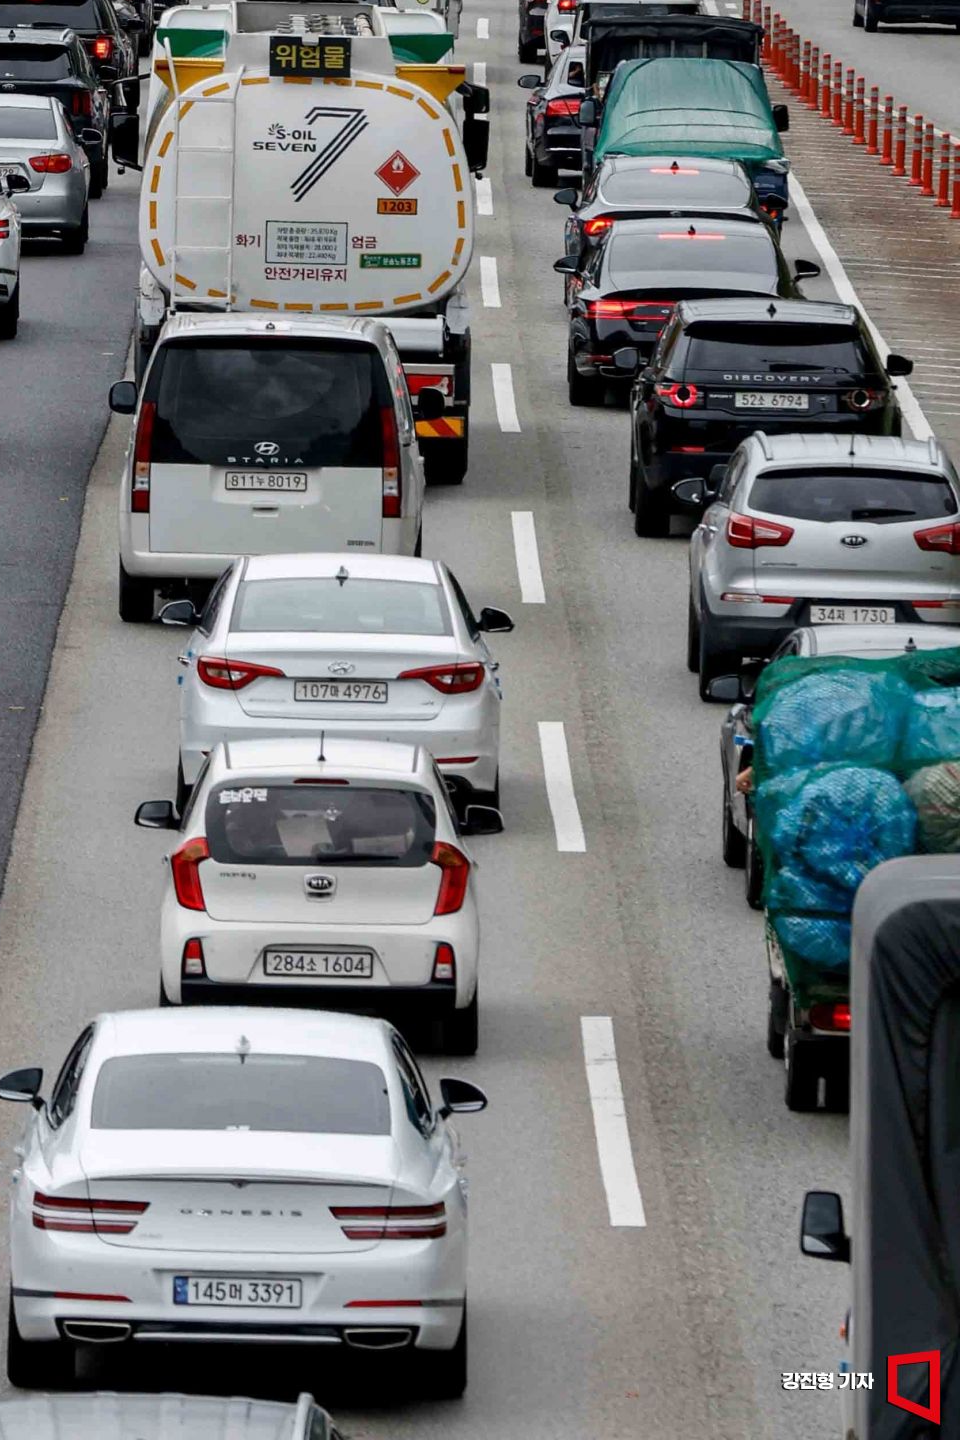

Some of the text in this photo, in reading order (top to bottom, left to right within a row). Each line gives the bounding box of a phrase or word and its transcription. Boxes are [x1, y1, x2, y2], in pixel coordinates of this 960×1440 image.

[276, 45, 345, 68] 위험물
[276, 129, 316, 140] S-OIL
[253, 142, 316, 153] SEVEN
[383, 201, 412, 212] 1203
[236, 234, 261, 247] 화기
[351, 236, 378, 249] 엄금
[264, 267, 347, 282] 안전거리유지
[723, 374, 821, 382] DISCOVERY
[771, 395, 802, 407] 6794
[268, 475, 301, 488] 8019
[853, 610, 888, 623] 1730
[343, 685, 381, 699] 4976
[273, 955, 364, 972] 284소 1604
[180, 1209, 302, 1217] GENESIS
[248, 1283, 293, 1303] 3391
